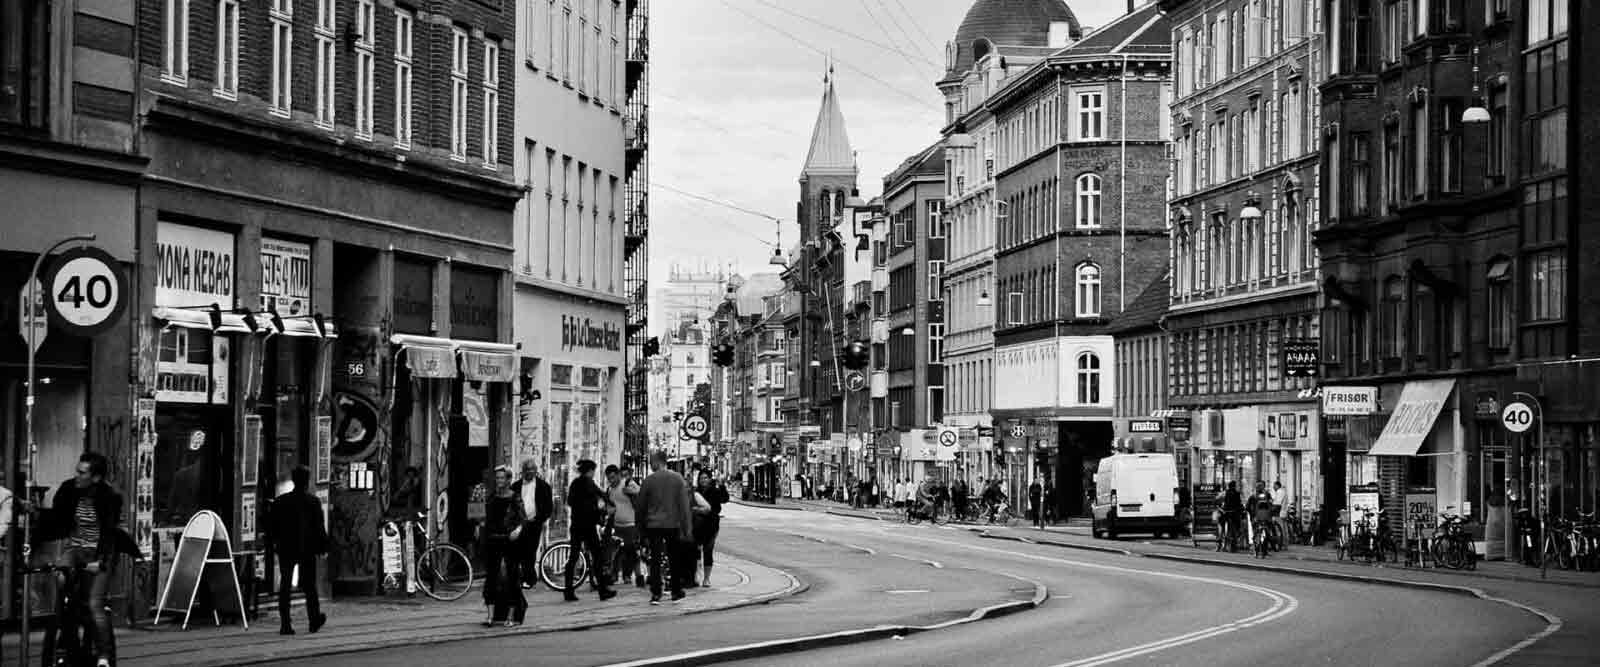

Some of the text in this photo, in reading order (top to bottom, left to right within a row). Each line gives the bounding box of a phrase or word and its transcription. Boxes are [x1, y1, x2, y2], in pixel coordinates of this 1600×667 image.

[157, 243, 231, 297] MONA KEBAB
[57, 274, 112, 309] 40
[348, 363, 364, 375] 56
[1504, 410, 1530, 425] 40
[687, 421, 705, 432] 40
